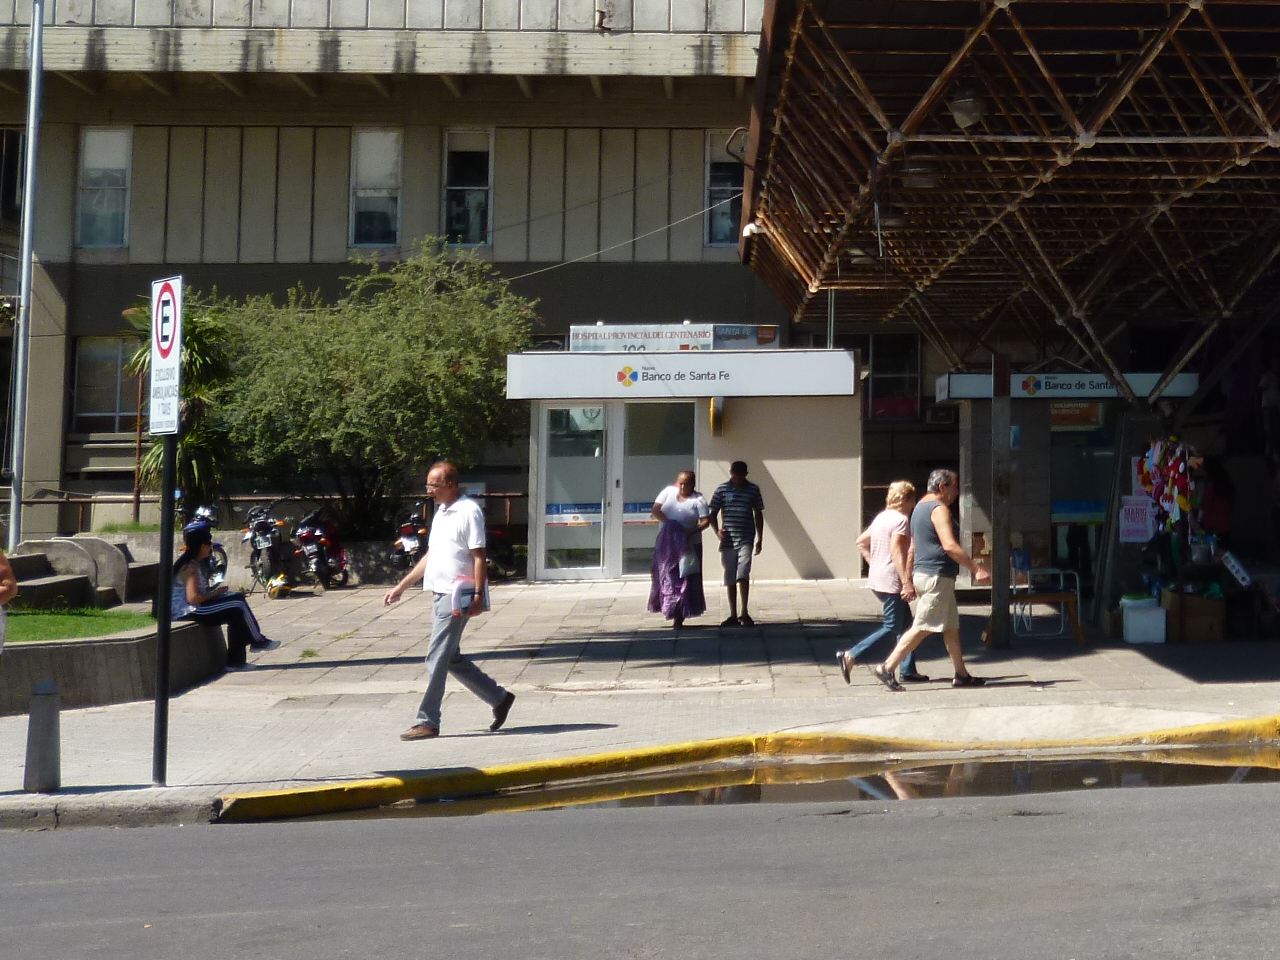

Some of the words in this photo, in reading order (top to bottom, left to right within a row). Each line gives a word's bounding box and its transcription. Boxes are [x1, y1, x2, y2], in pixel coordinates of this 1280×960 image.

[161, 299, 170, 343] E
[572, 332, 607, 340] HOSPITAL
[607, 331, 651, 340] PROVINCIAL
[664, 330, 711, 339] CENTENARIO
[155, 367, 175, 382] EXCLUSIVO
[642, 372, 671, 381] Banco
[674, 371, 686, 381] de
[689, 371, 716, 381] Santa
[719, 371, 730, 380] Fe
[1044, 381, 1072, 390] Banco
[1075, 381, 1086, 390] de
[1089, 381, 1114, 390] Santa
